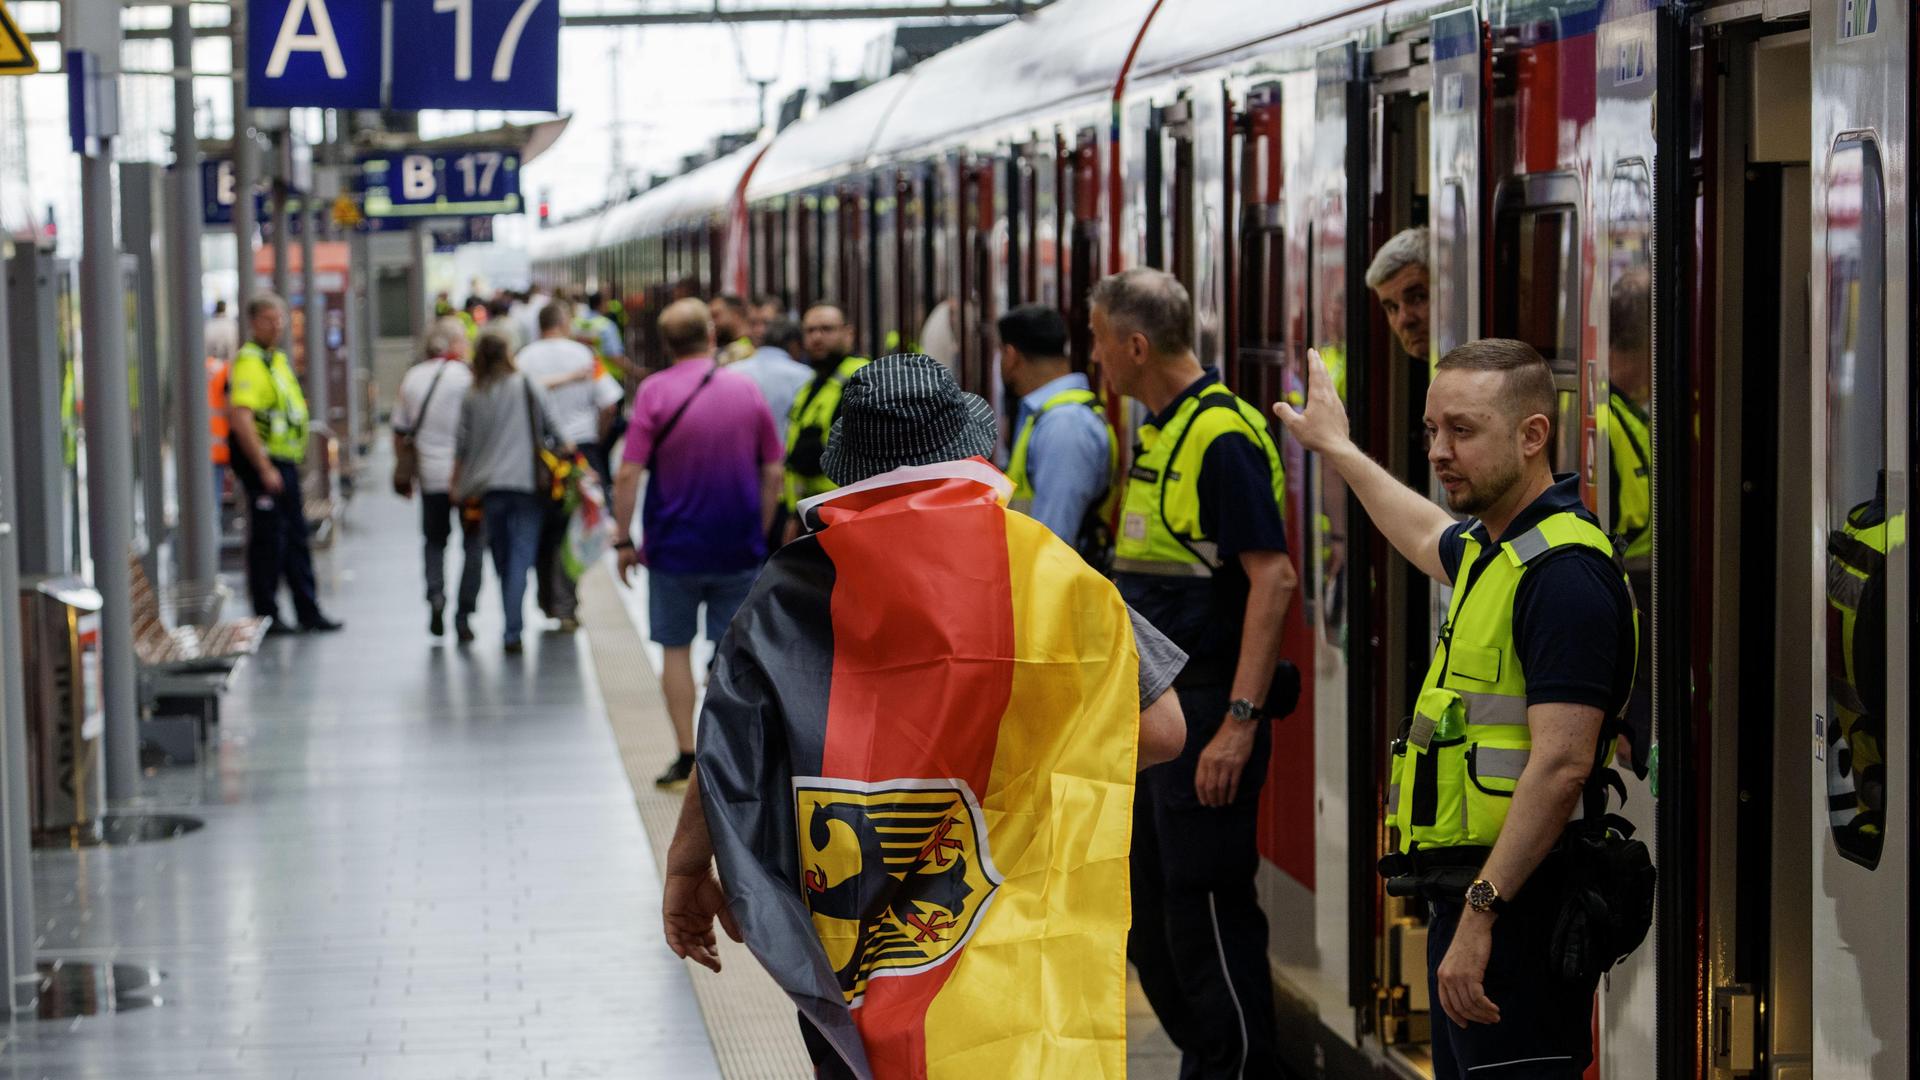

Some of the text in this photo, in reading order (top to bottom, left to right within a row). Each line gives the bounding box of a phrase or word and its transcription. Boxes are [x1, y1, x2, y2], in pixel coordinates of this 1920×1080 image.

[265, 0, 543, 82] A 17
[402, 153, 500, 200] B 17
